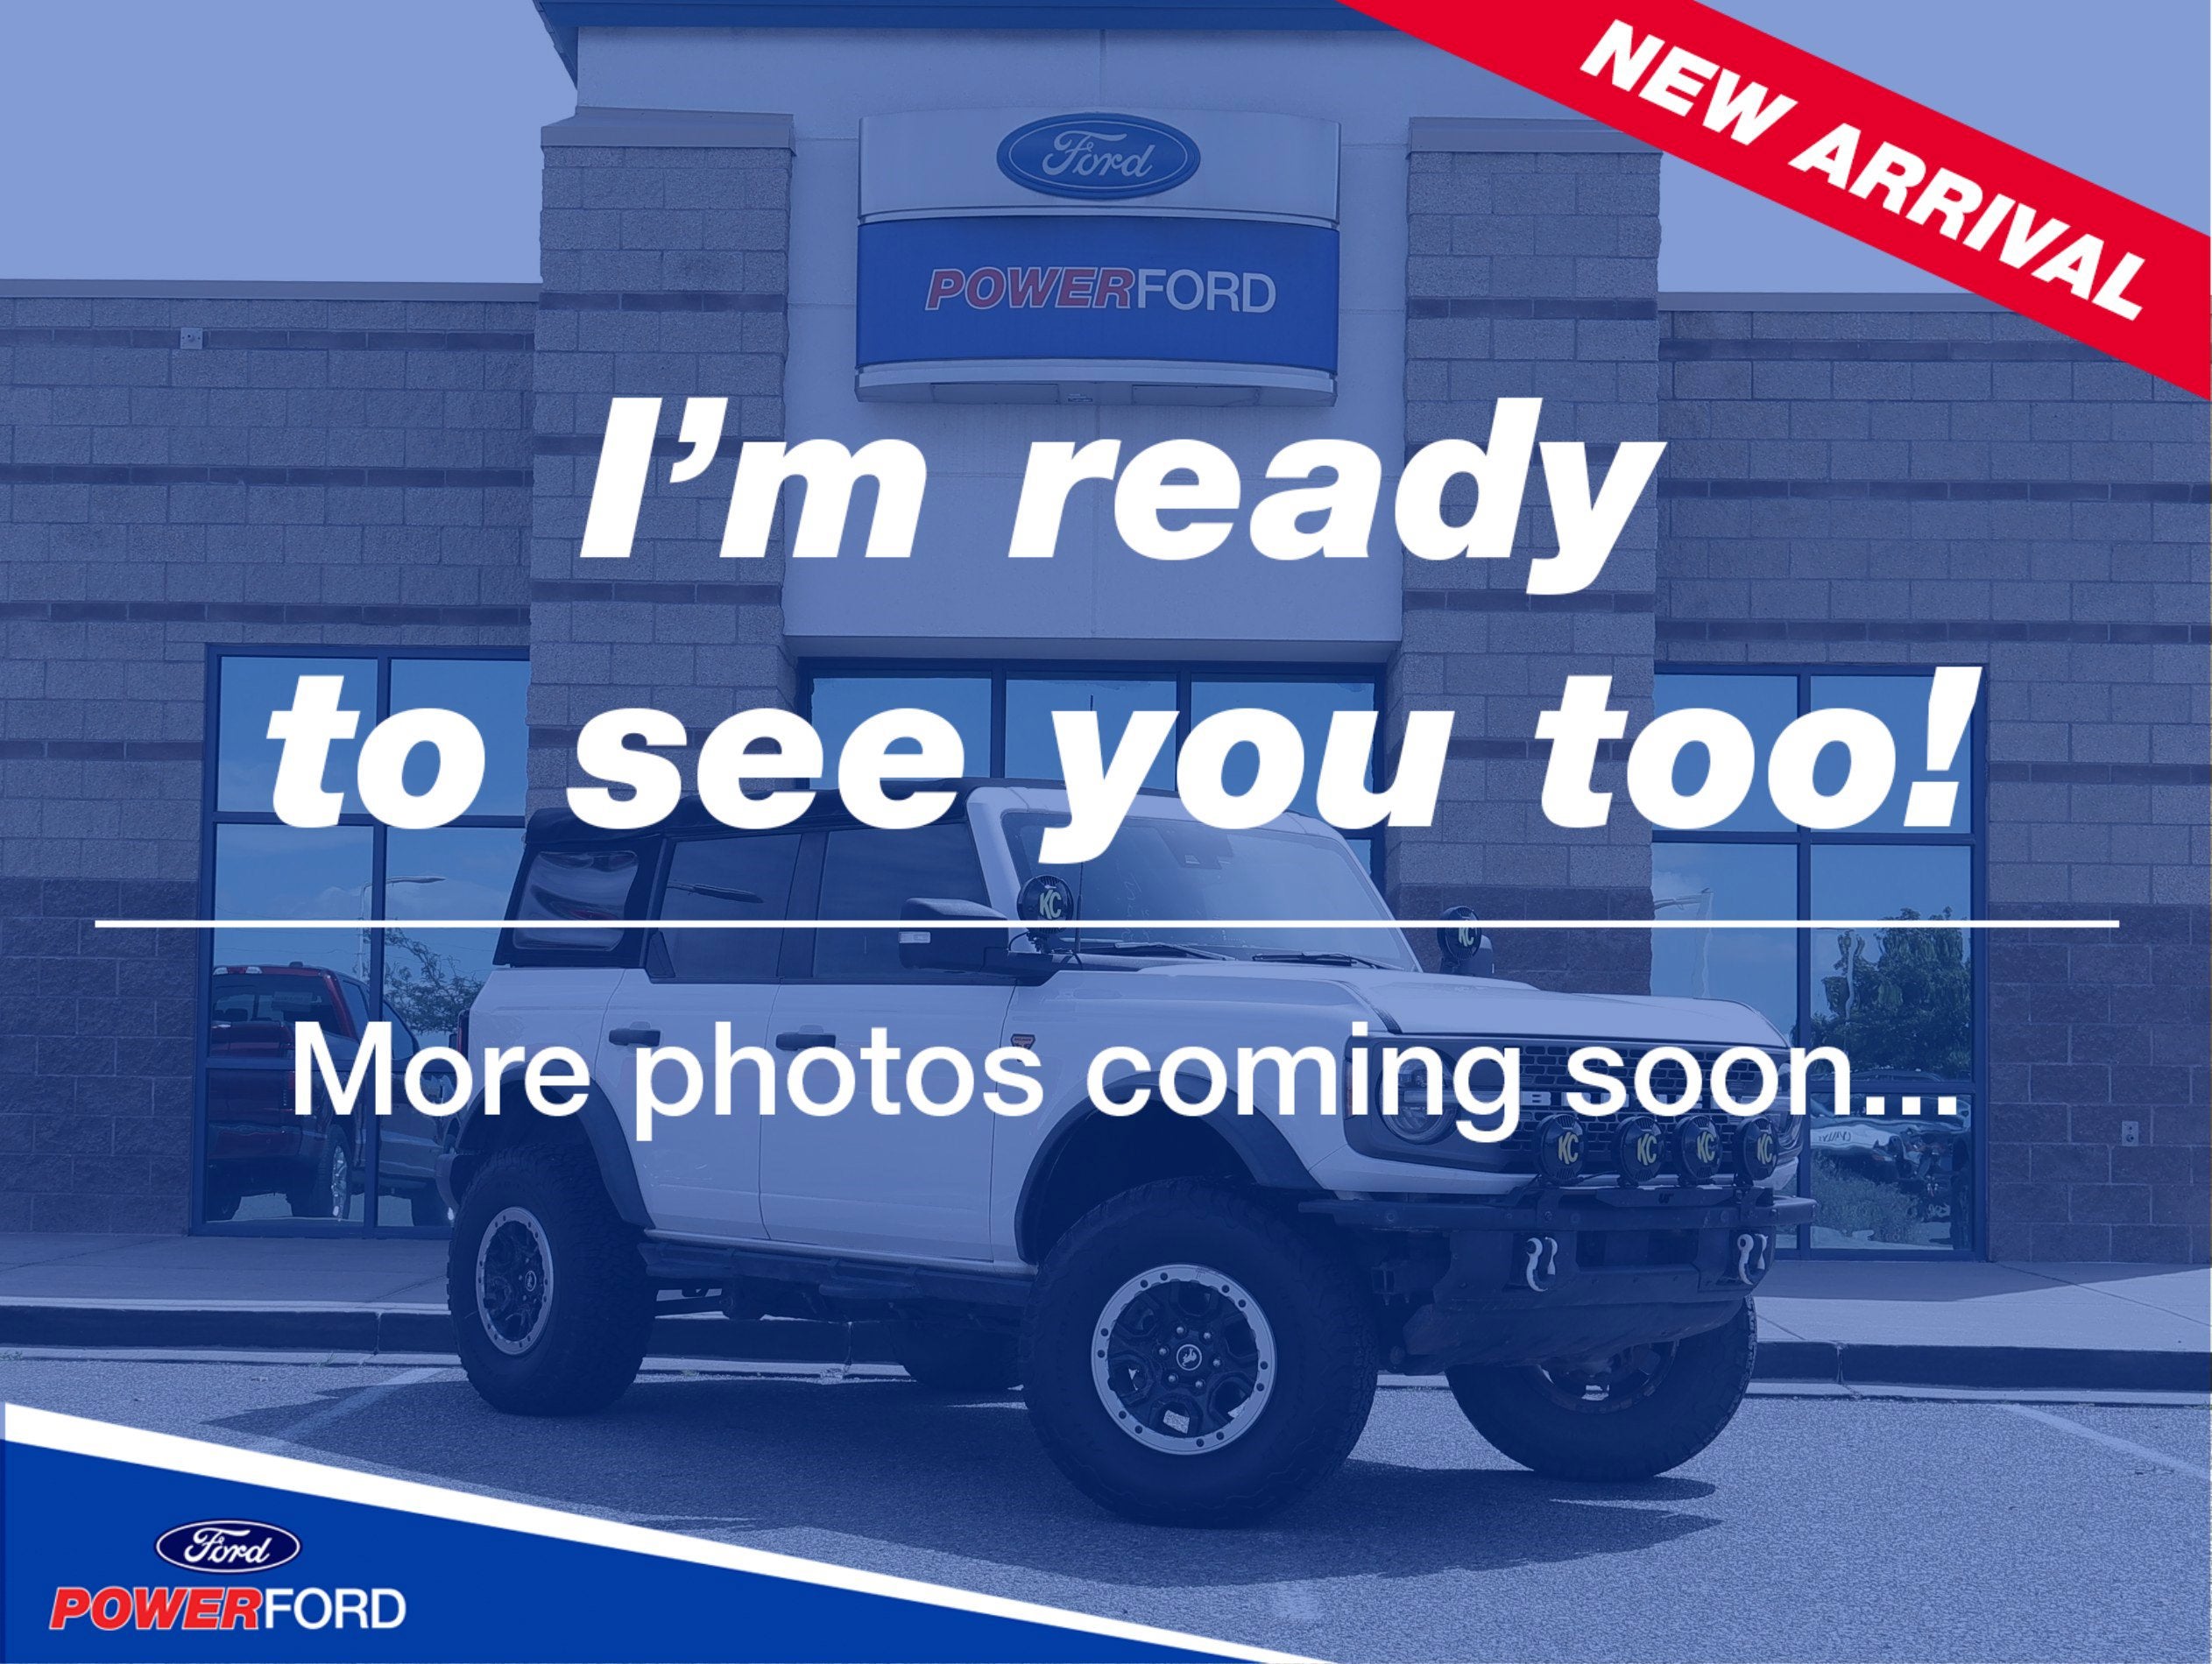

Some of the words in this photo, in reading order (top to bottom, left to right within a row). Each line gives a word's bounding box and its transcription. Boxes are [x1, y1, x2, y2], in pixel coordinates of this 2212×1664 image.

[1042, 129, 1156, 179] Ford
[1039, 889, 1062, 920] KC
[1557, 1132, 1579, 1166] KC
[1636, 1132, 1658, 1166] KC
[1696, 1131, 1716, 1163] KC
[1756, 1131, 1775, 1164] KC
